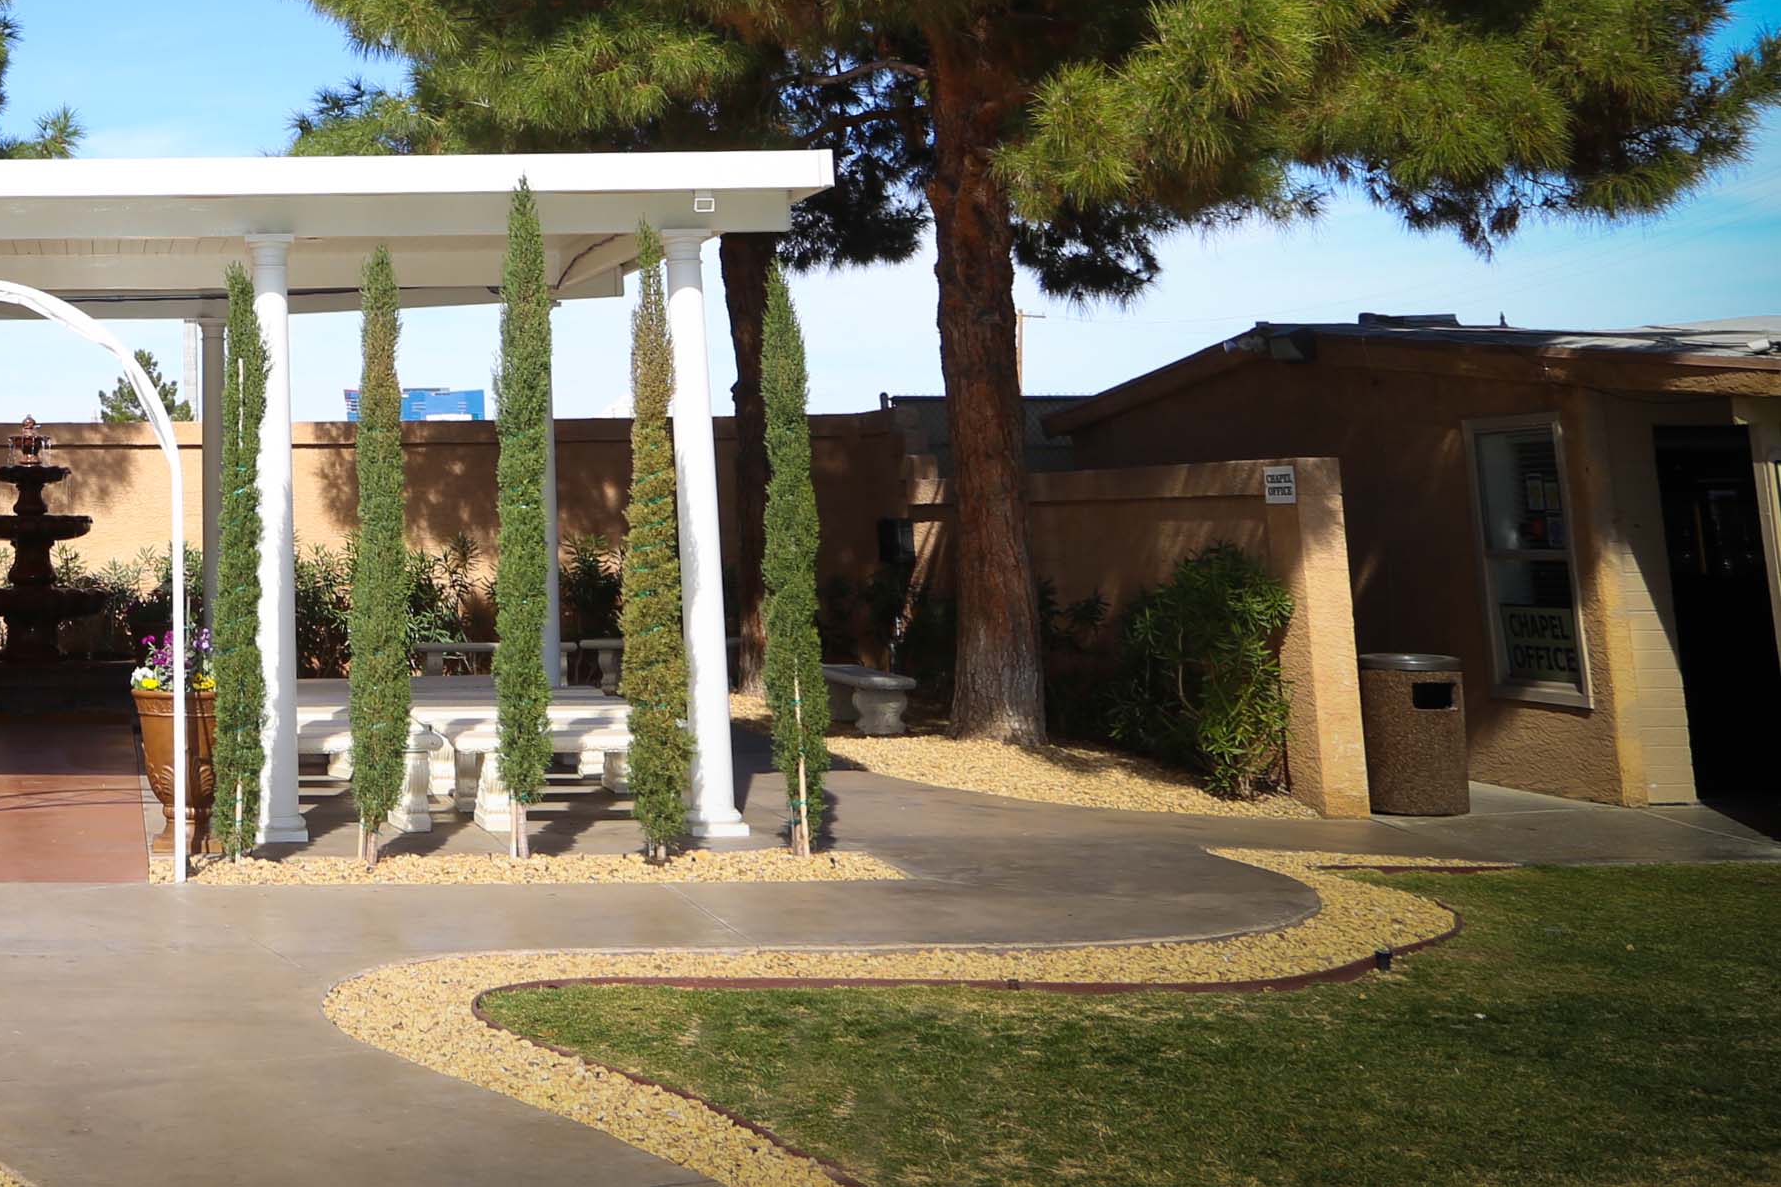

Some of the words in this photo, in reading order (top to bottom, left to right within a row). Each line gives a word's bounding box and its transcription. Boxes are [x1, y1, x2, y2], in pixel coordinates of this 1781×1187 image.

[1266, 474, 1292, 484] CHAPEL
[1268, 486, 1292, 496] OFFICE
[1509, 613, 1571, 640] CHAPEL
[1513, 644, 1579, 672] OFFICE
